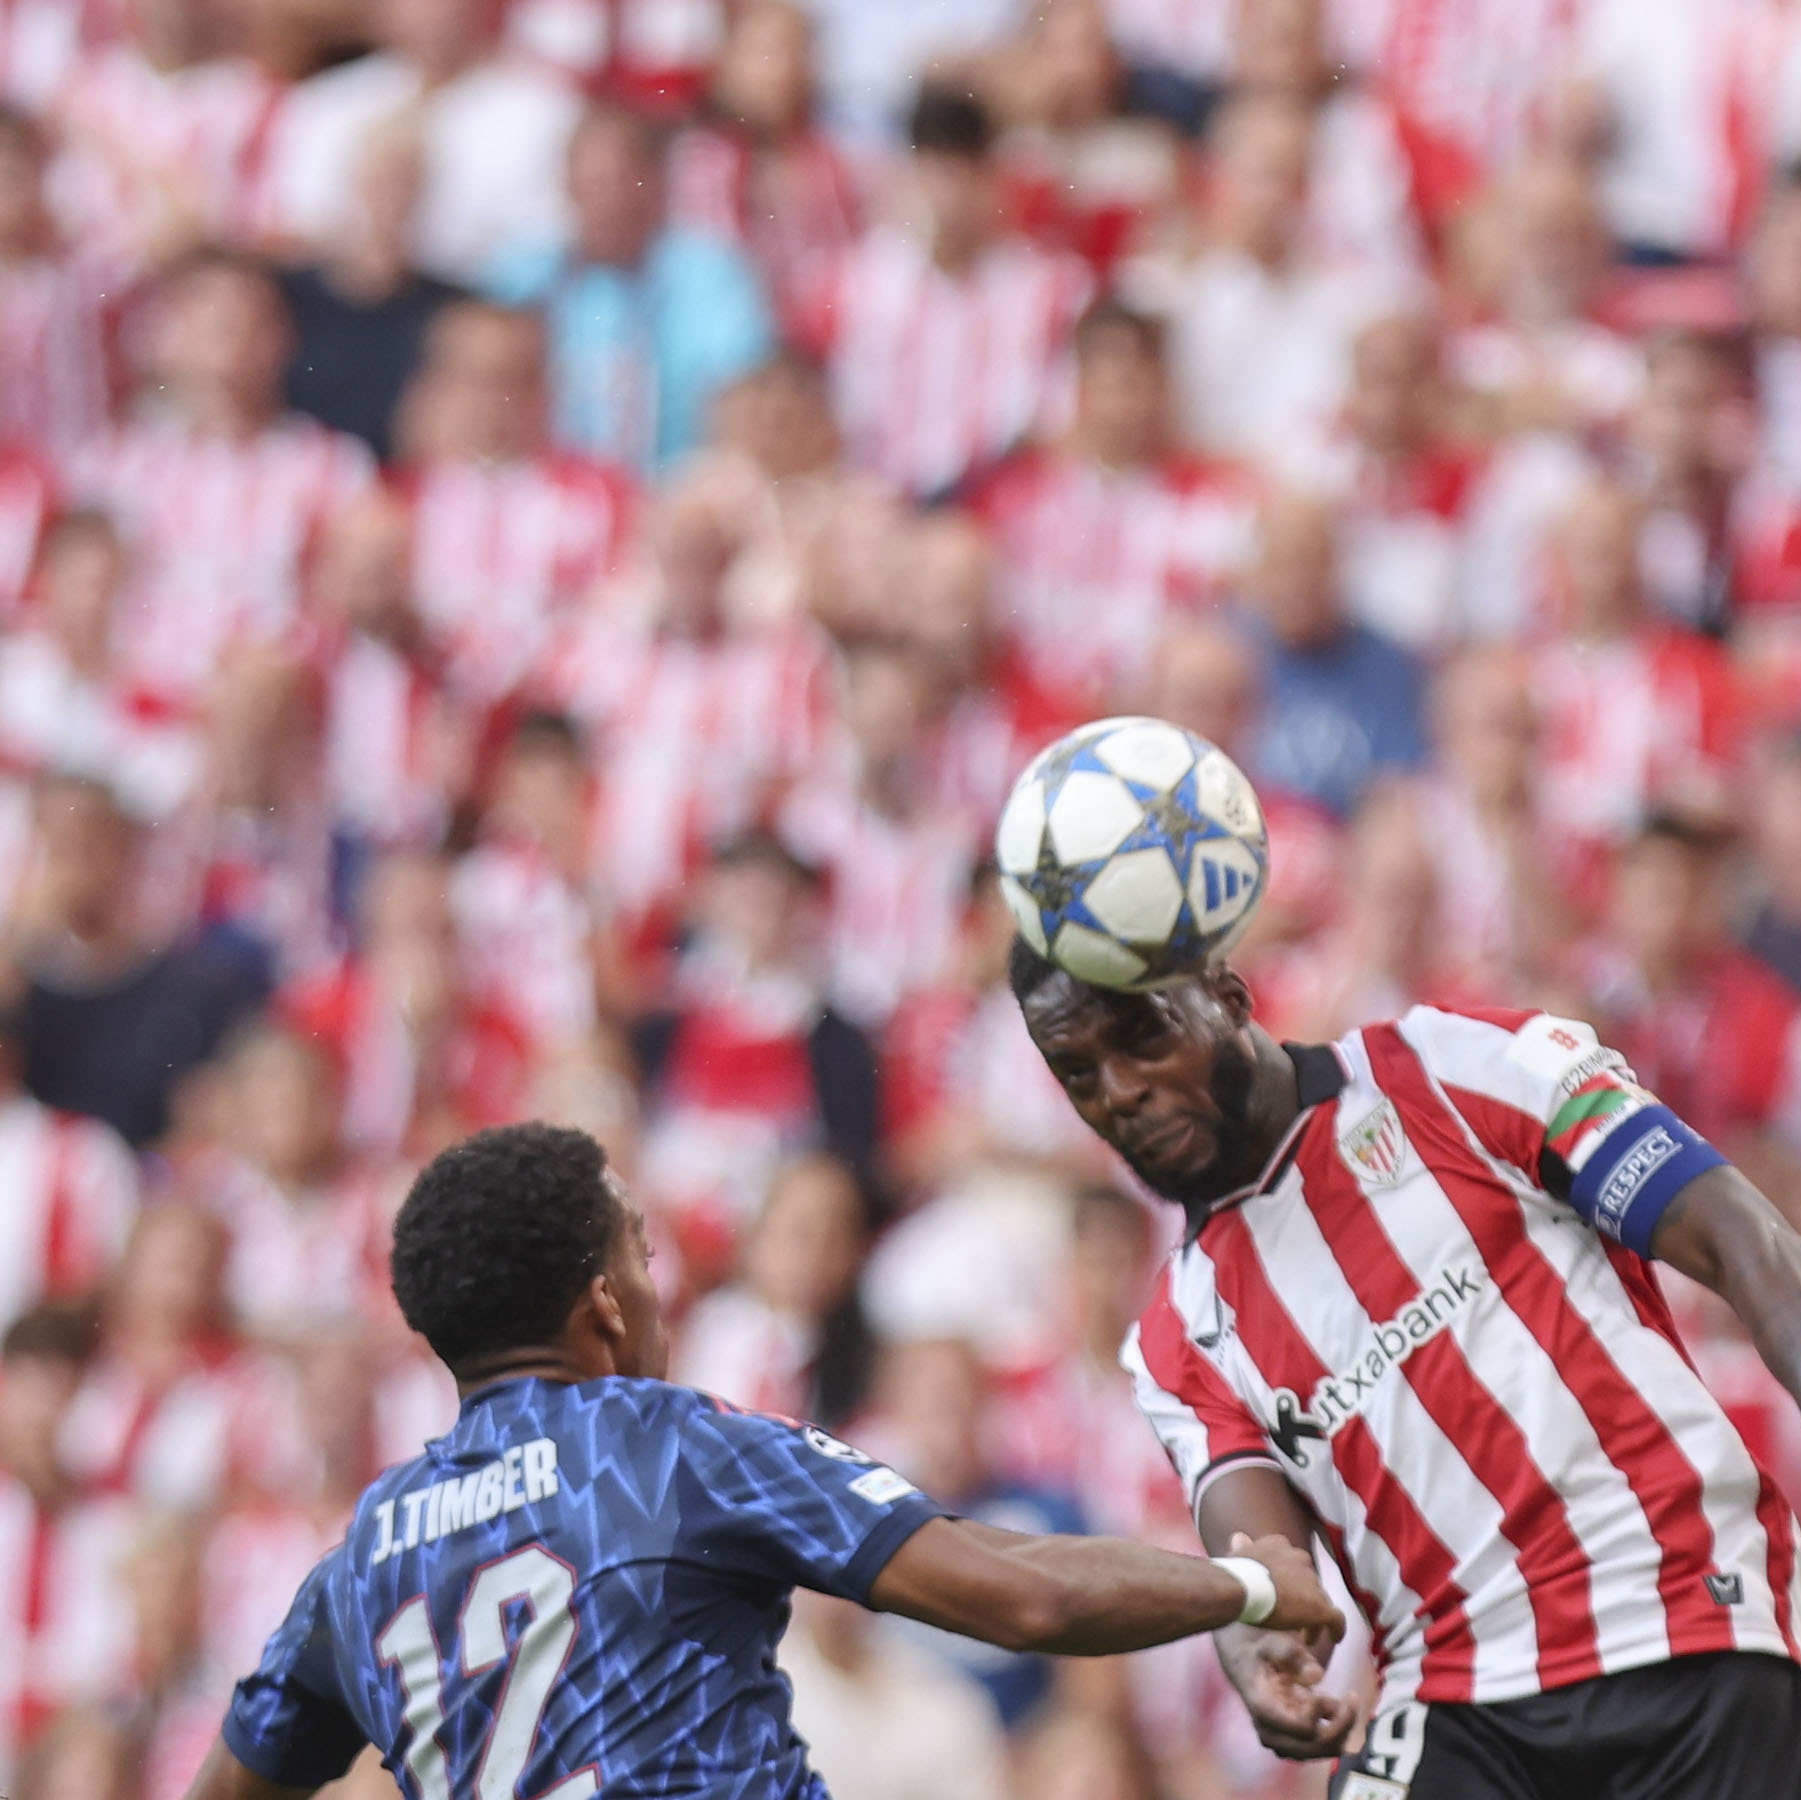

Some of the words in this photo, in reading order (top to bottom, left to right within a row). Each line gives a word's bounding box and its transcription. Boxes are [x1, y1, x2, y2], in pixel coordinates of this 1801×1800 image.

[1603, 1129, 1676, 1213] RESPECT
[1269, 1267, 1482, 1469] Kutxabank
[371, 1436, 558, 1565] J.TIMBER
